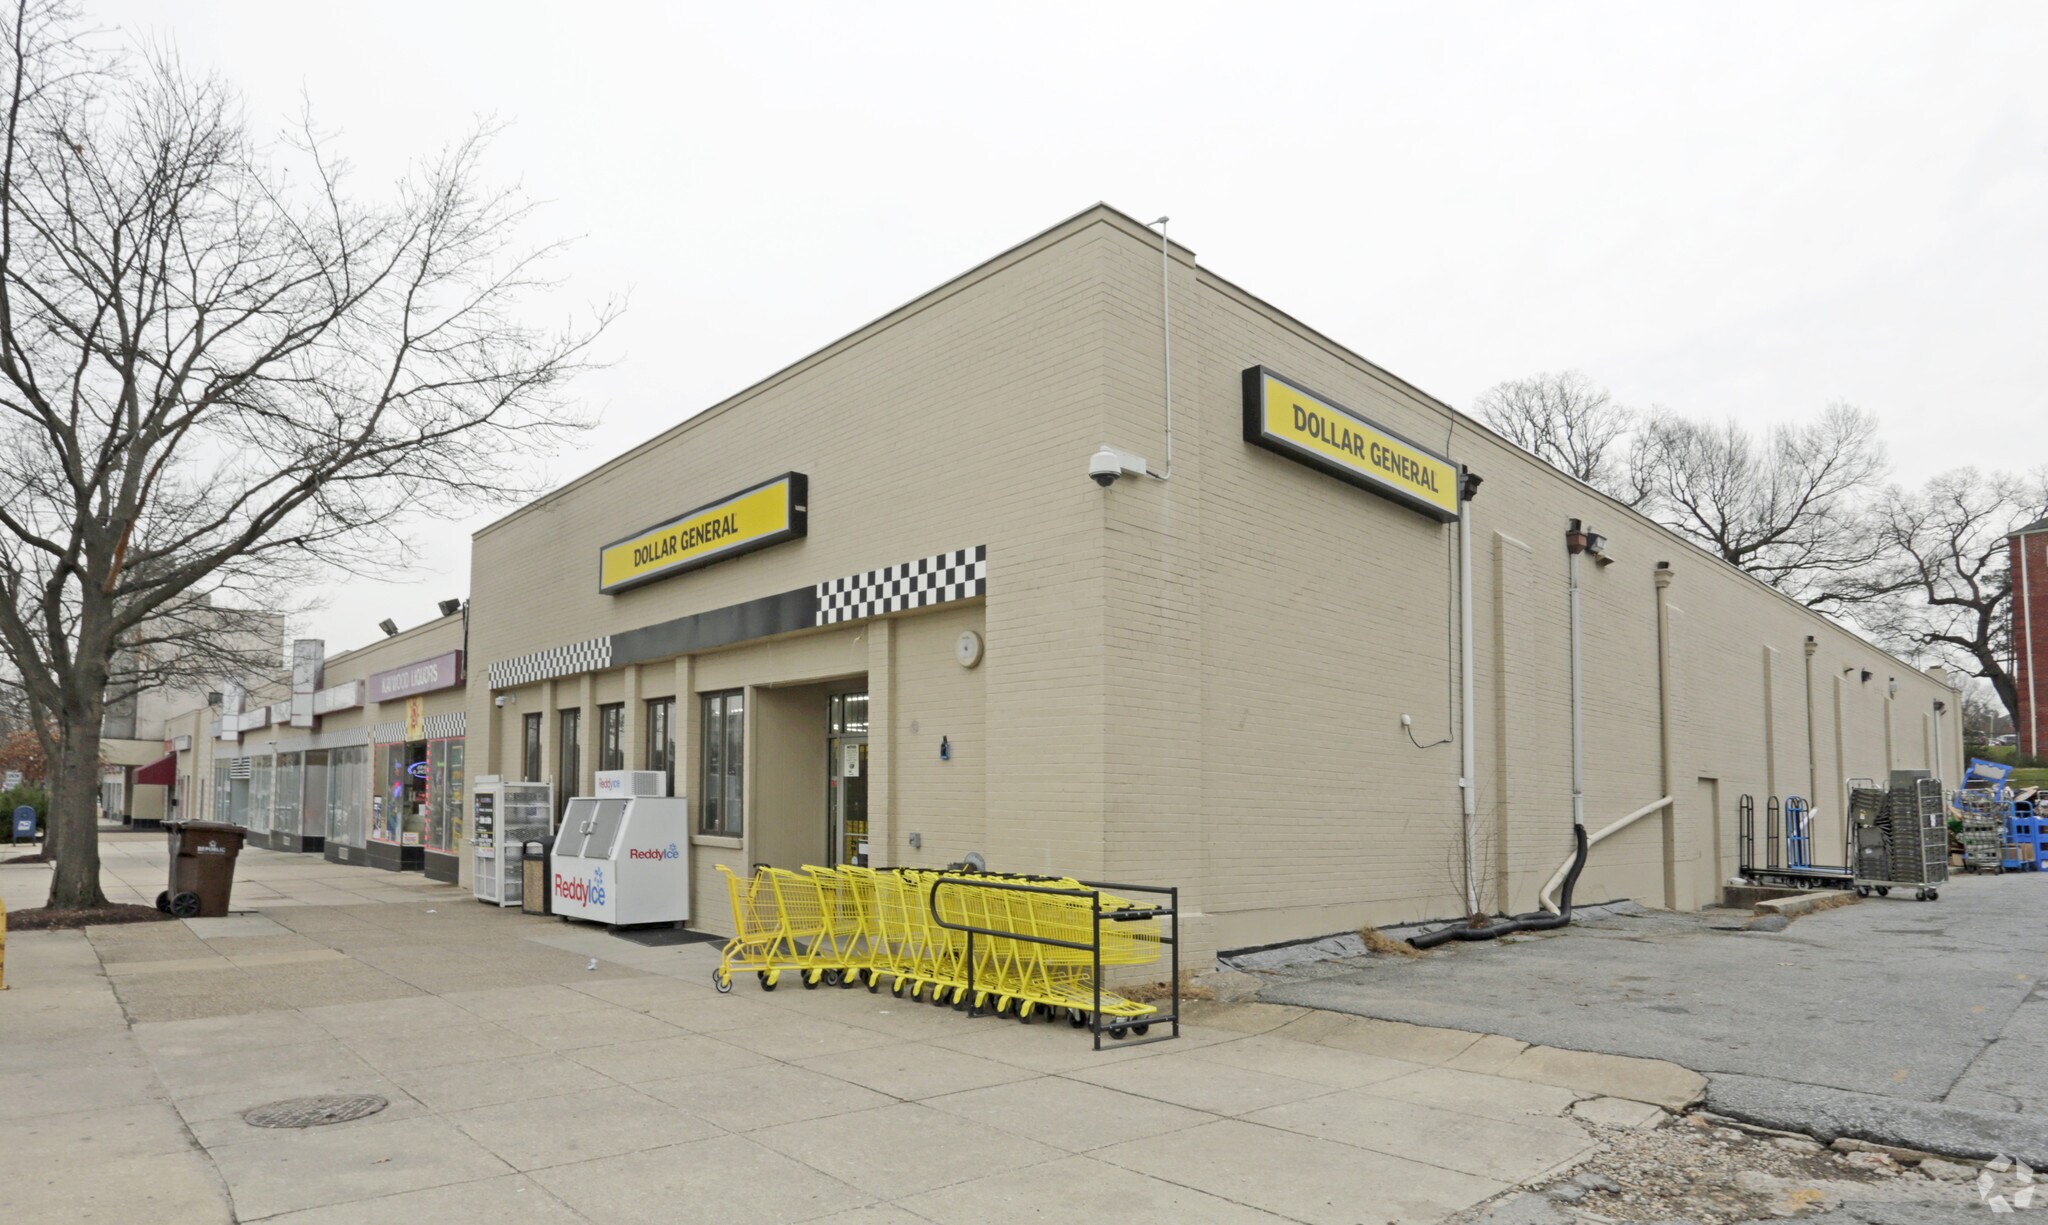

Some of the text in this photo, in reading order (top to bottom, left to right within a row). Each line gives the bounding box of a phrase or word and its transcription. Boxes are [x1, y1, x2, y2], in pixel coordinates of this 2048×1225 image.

[1293, 403, 1439, 494] DOLLAR GENERAL
[634, 513, 738, 567] DOLLAR GENERAL
[410, 663, 438, 687] LIQUORS
